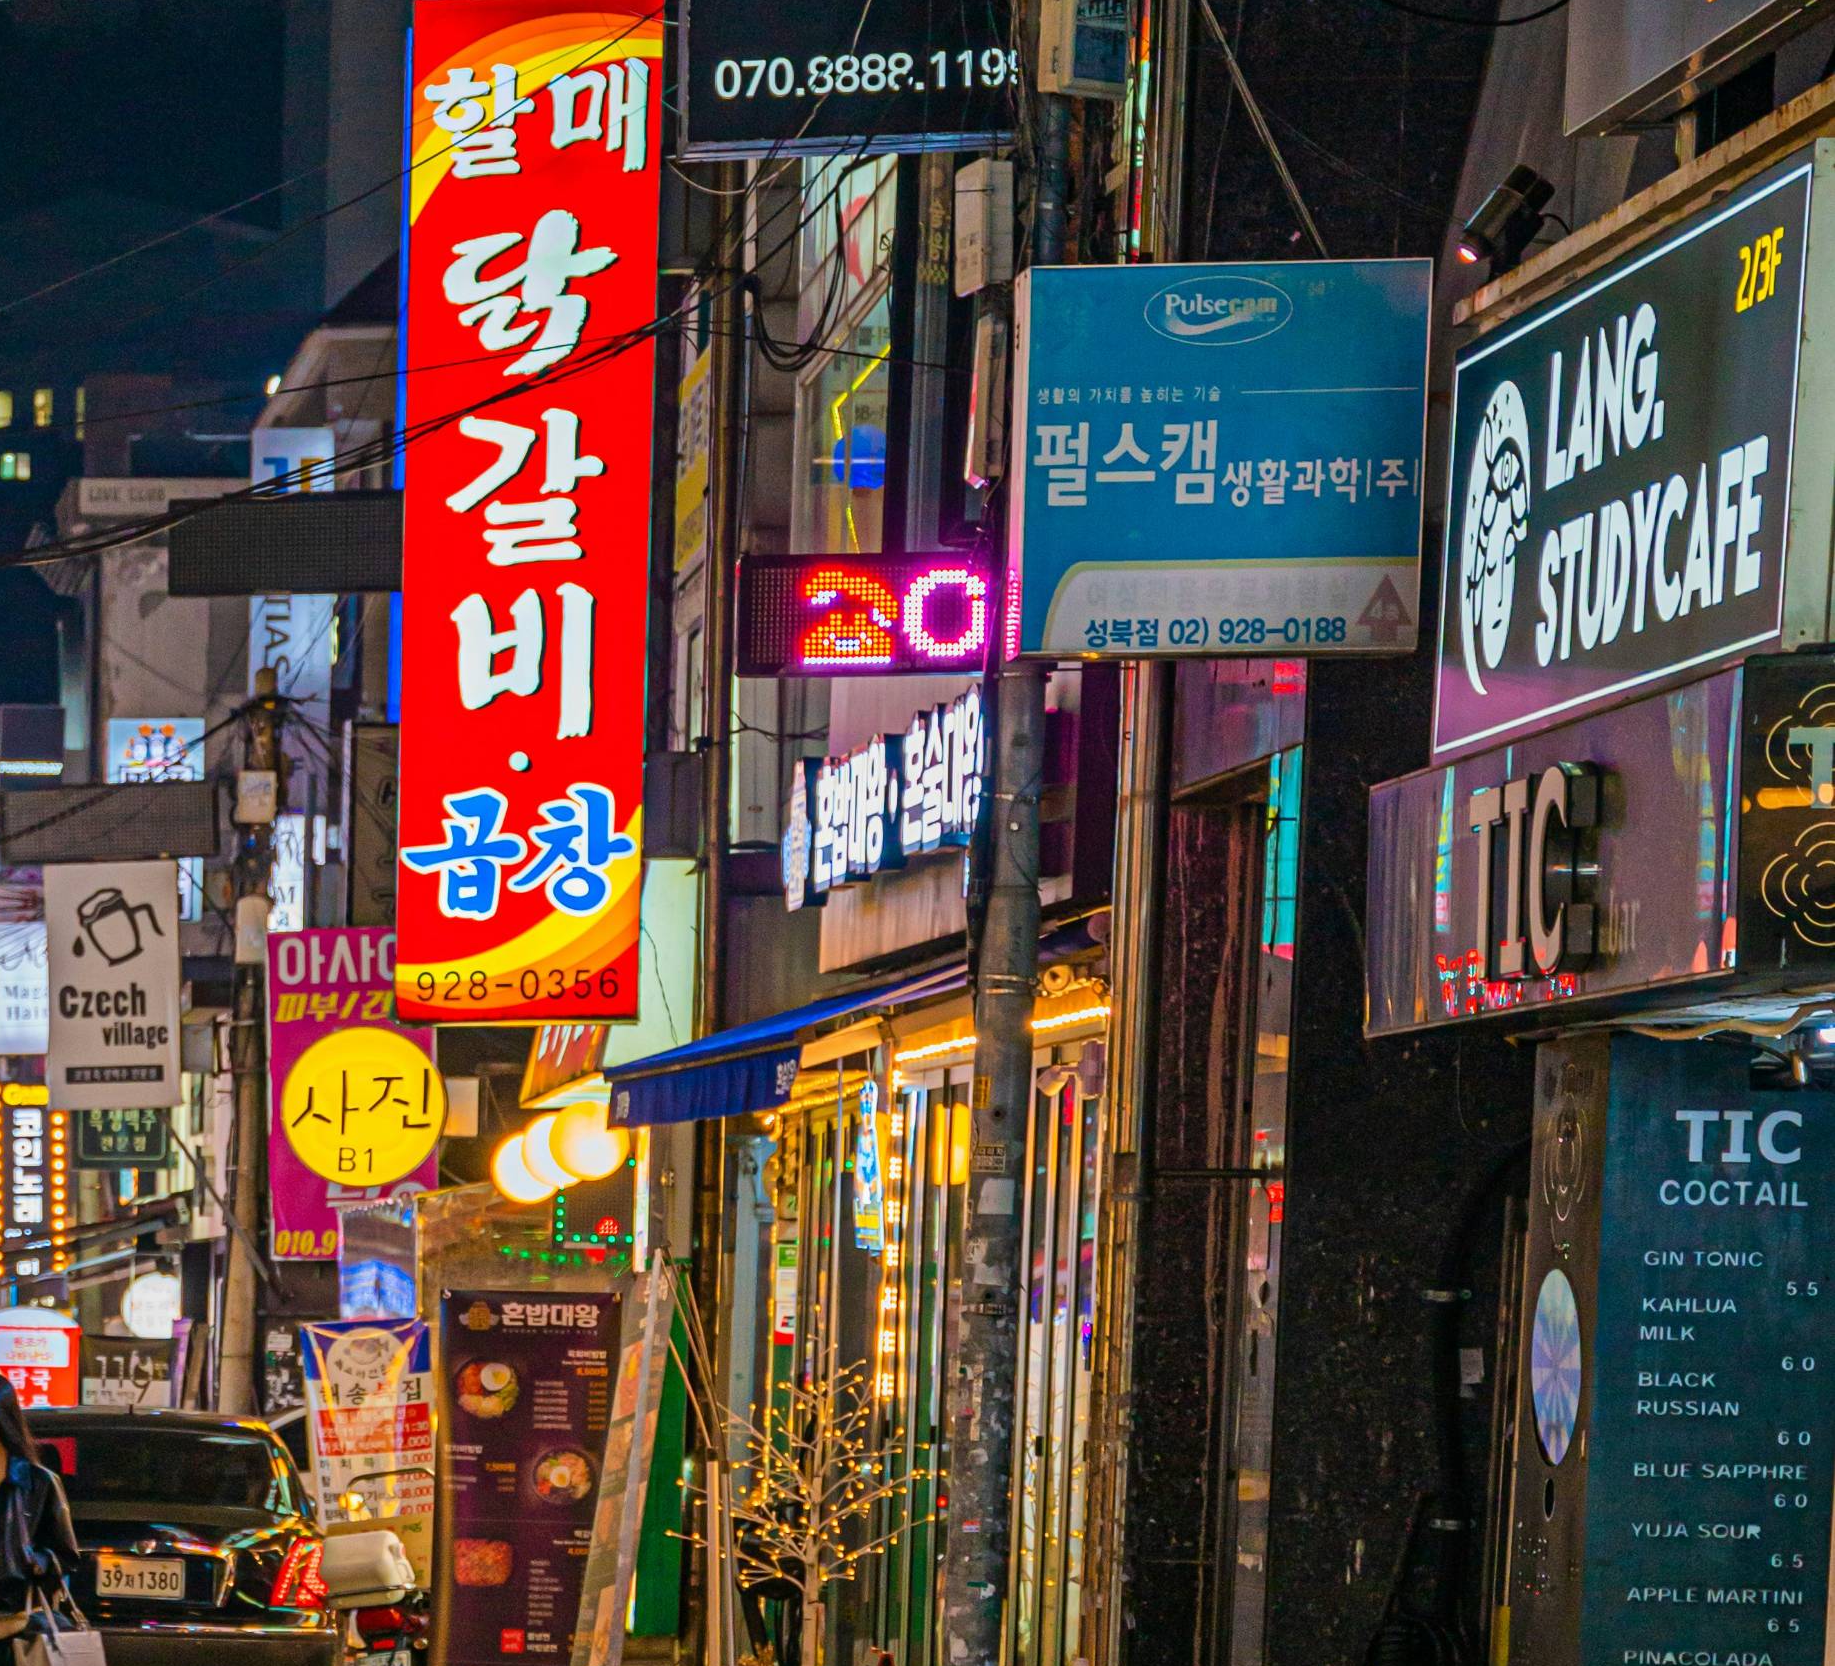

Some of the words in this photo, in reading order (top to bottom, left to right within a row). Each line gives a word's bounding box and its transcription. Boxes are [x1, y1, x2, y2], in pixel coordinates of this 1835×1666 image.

[423, 56, 649, 180] 할매
[1165, 293, 1278, 318] Pulsecam
[1037, 387, 1080, 405] 생활의
[1089, 386, 1132, 404] 가치를
[1194, 385, 1221, 403] 기술
[1545, 301, 1664, 491] LANG.
[444, 209, 619, 741] 닭갈비
[1035, 420, 1220, 507] 펄스캠
[1535, 434, 1769, 668] STUDYCAFE
[1084, 618, 1159, 647] 성북점
[1169, 617, 1209, 646] 02)
[1219, 617, 1347, 645] 928-0188
[401, 783, 636, 920] 곱창
[1469, 762, 1566, 984] TIC
[417, 969, 620, 1002] 928-0356
[59, 983, 146, 1019] Czech
[102, 1022, 169, 1050] village
[292, 1069, 431, 1135] 사진
[1675, 1110, 1804, 1164] TIC
[338, 1147, 374, 1172] B1
[1658, 1179, 1808, 1208] COCTAIL
[1644, 1250, 1684, 1266] GIN
[1693, 1251, 1764, 1267] TONIC
[1786, 1281, 1818, 1296] 5.5
[501, 1302, 600, 1328] 혼밥대왕
[1642, 1298, 1737, 1313] KAHLUA
[1639, 1325, 1695, 1341] MILK
[1638, 1372, 1716, 1388] BLACK
[1637, 1400, 1740, 1417] RUSSIAN
[1633, 1463, 1692, 1479] BLUE
[1631, 1523, 1689, 1538] YUJA
[1698, 1524, 1762, 1540] SOUR
[1627, 1587, 1698, 1603] APPLE
[1707, 1588, 1803, 1606] MARTINI
